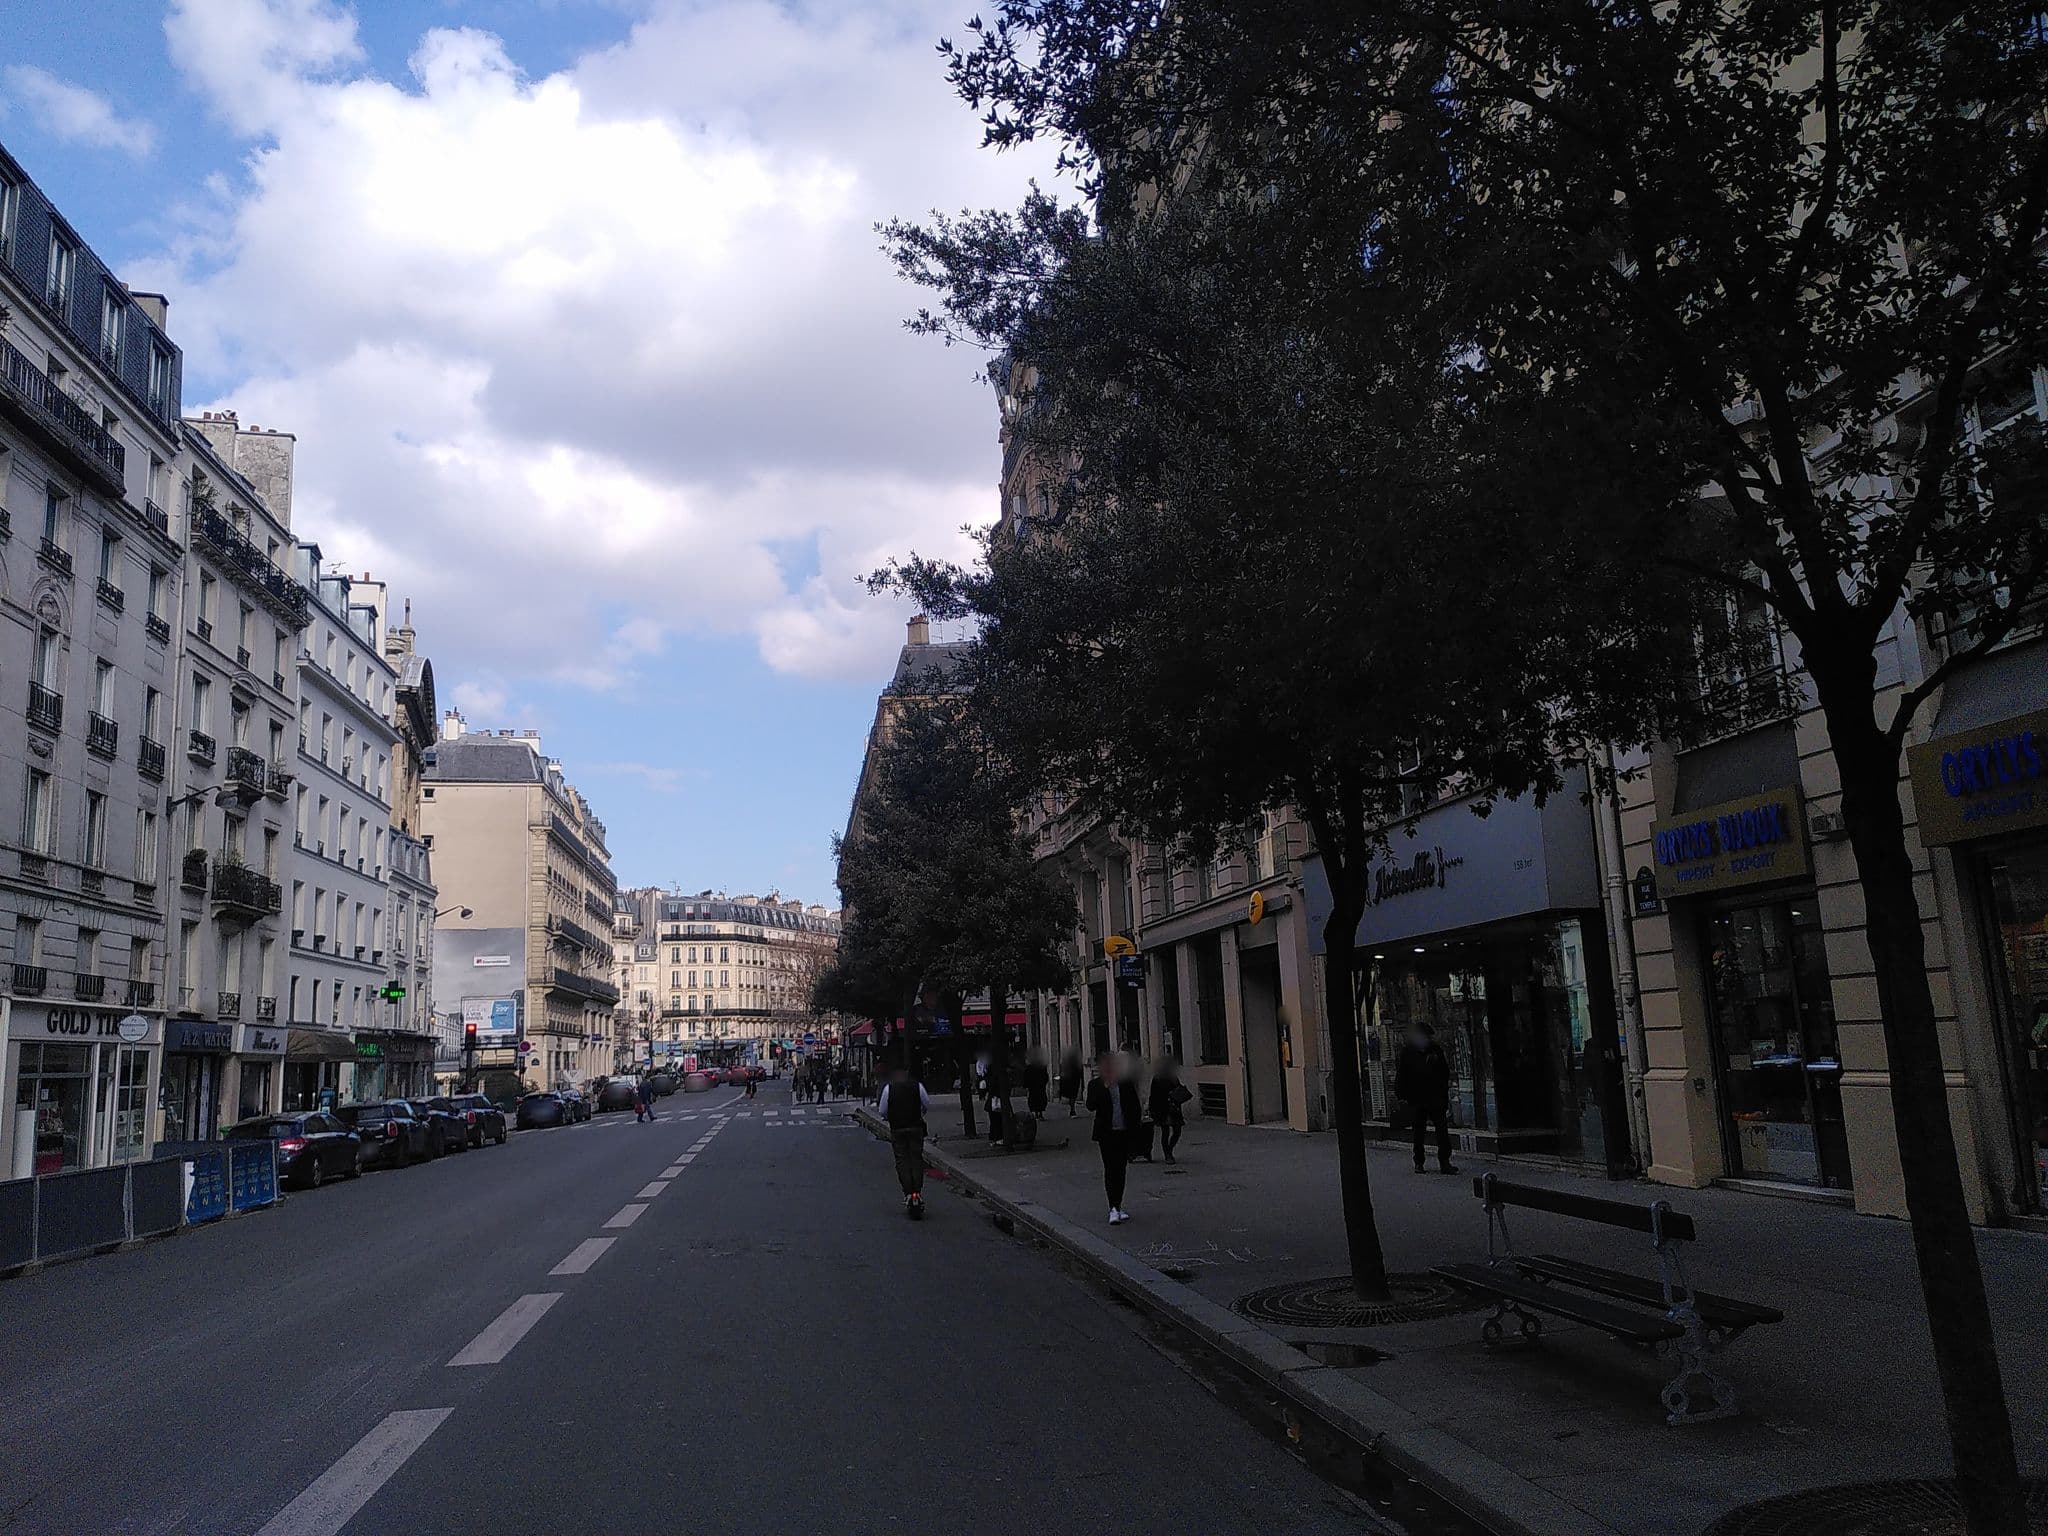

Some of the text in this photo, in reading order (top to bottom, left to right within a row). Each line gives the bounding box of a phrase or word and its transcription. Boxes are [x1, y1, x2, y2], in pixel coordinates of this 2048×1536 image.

[1941, 730, 2041, 798] ORYLYS
[1655, 802, 1784, 866] ORYLYS BIJOUX
[1730, 851, 1777, 875] EXPORT
[47, 1009, 91, 1035] GOLD
